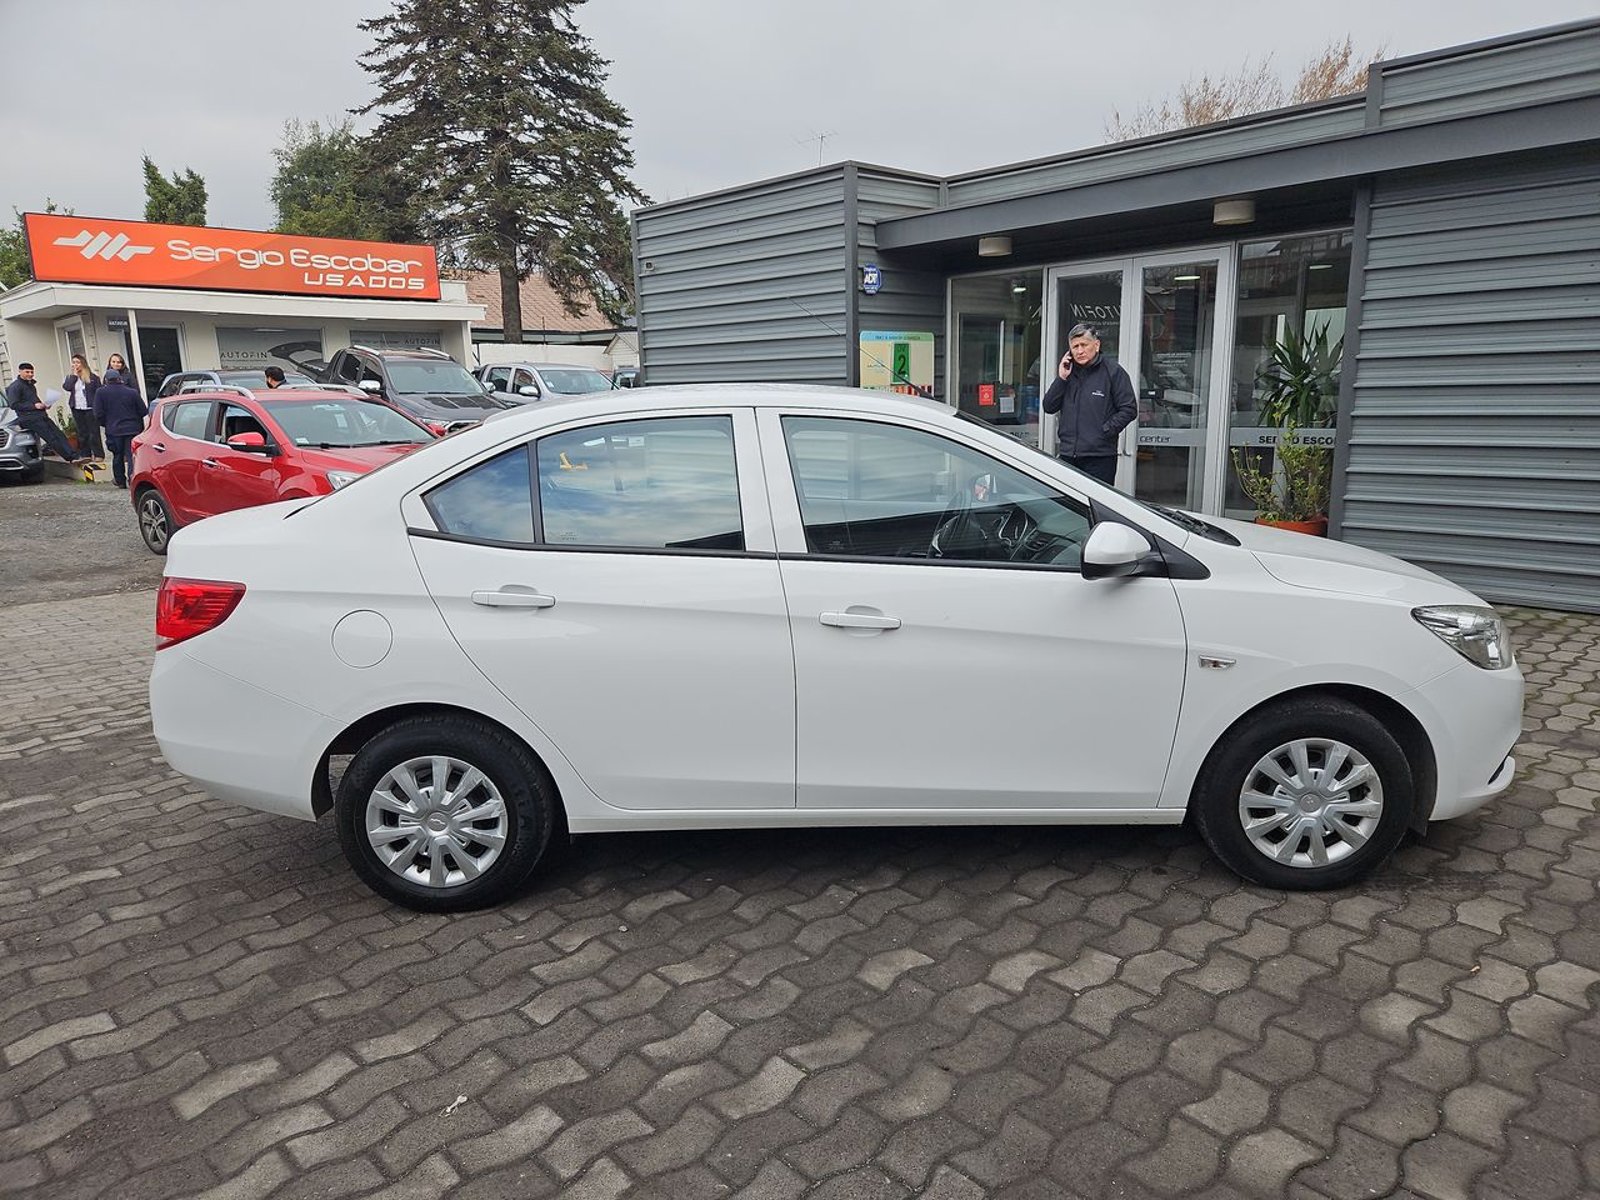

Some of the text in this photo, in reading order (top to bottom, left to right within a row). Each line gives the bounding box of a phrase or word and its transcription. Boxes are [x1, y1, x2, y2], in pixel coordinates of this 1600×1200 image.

[167, 239, 422, 274] Sergio Escobar
[304, 272, 425, 290] USADOS
[220, 351, 267, 359] AUTOFIN
[898, 354, 906, 375] 2
[1139, 434, 1171, 443] center
[1258, 435, 1300, 445] SERO
